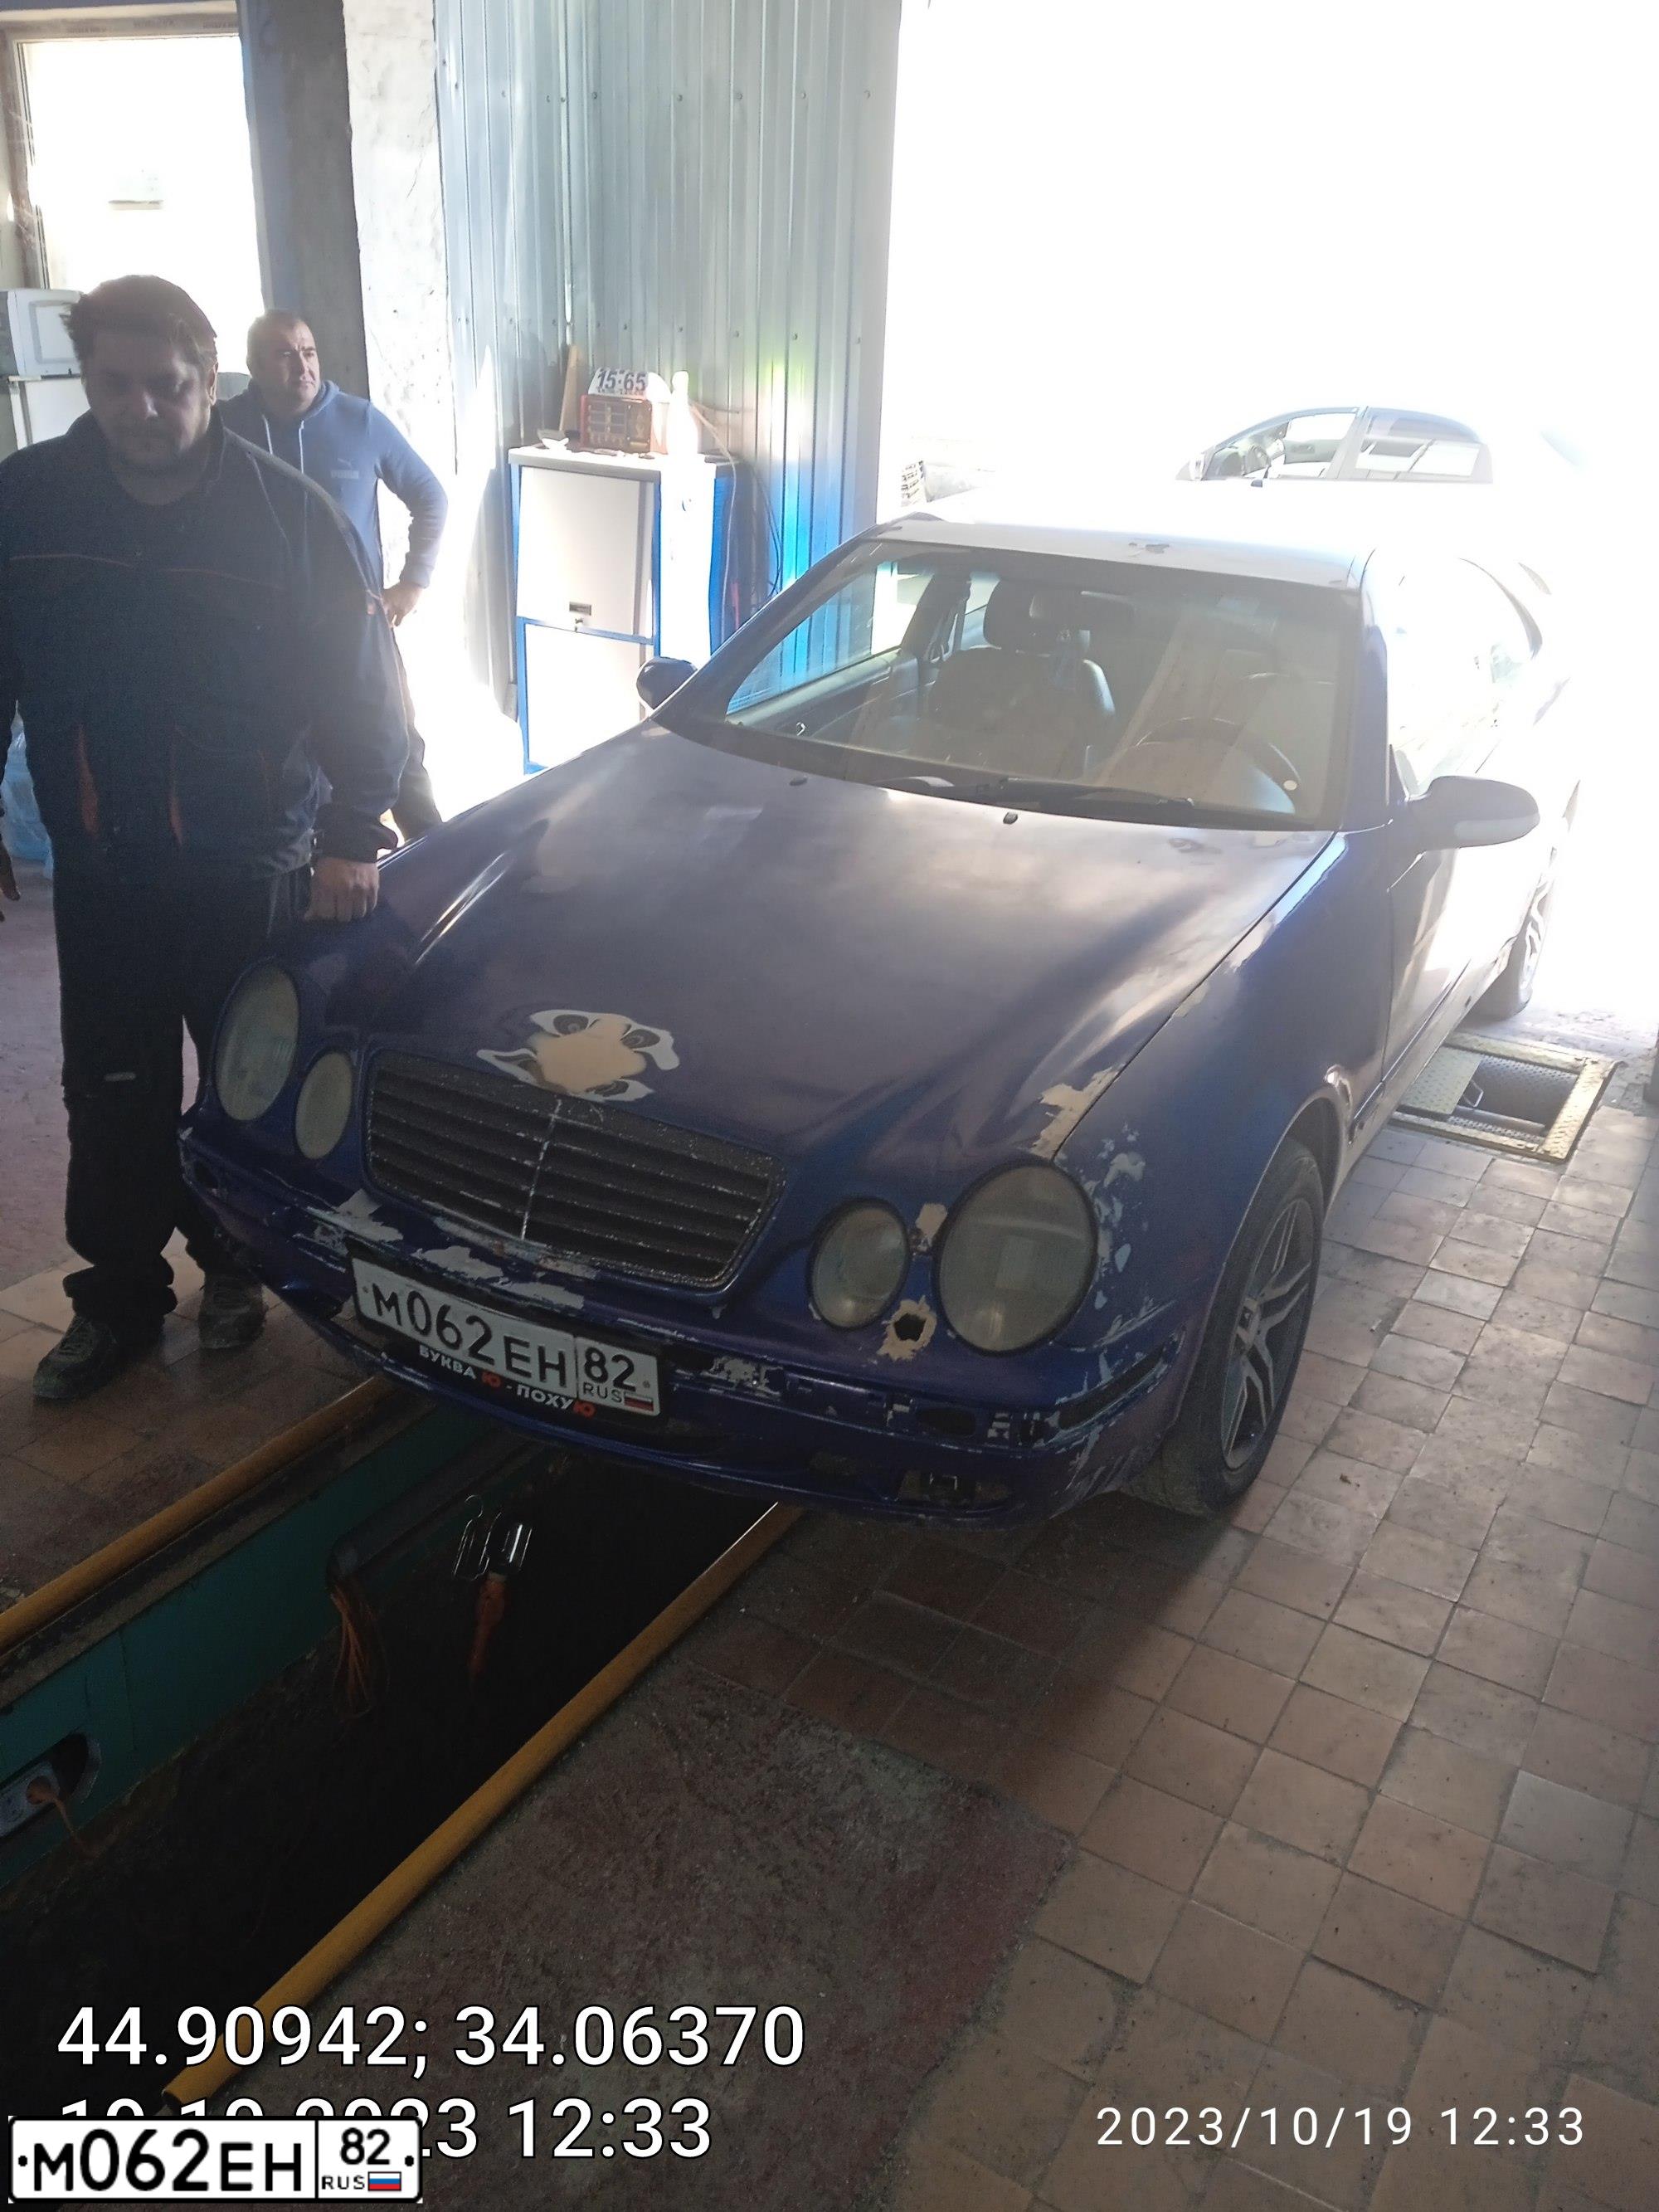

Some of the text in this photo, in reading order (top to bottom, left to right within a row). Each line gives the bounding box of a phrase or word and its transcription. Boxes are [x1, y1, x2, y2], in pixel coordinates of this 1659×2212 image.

[372, 1283, 567, 1389] М062ЕН
[419, 1344, 477, 1381] БУКВА
[584, 1347, 636, 1391] 82
[582, 1383, 623, 1403] RUS
